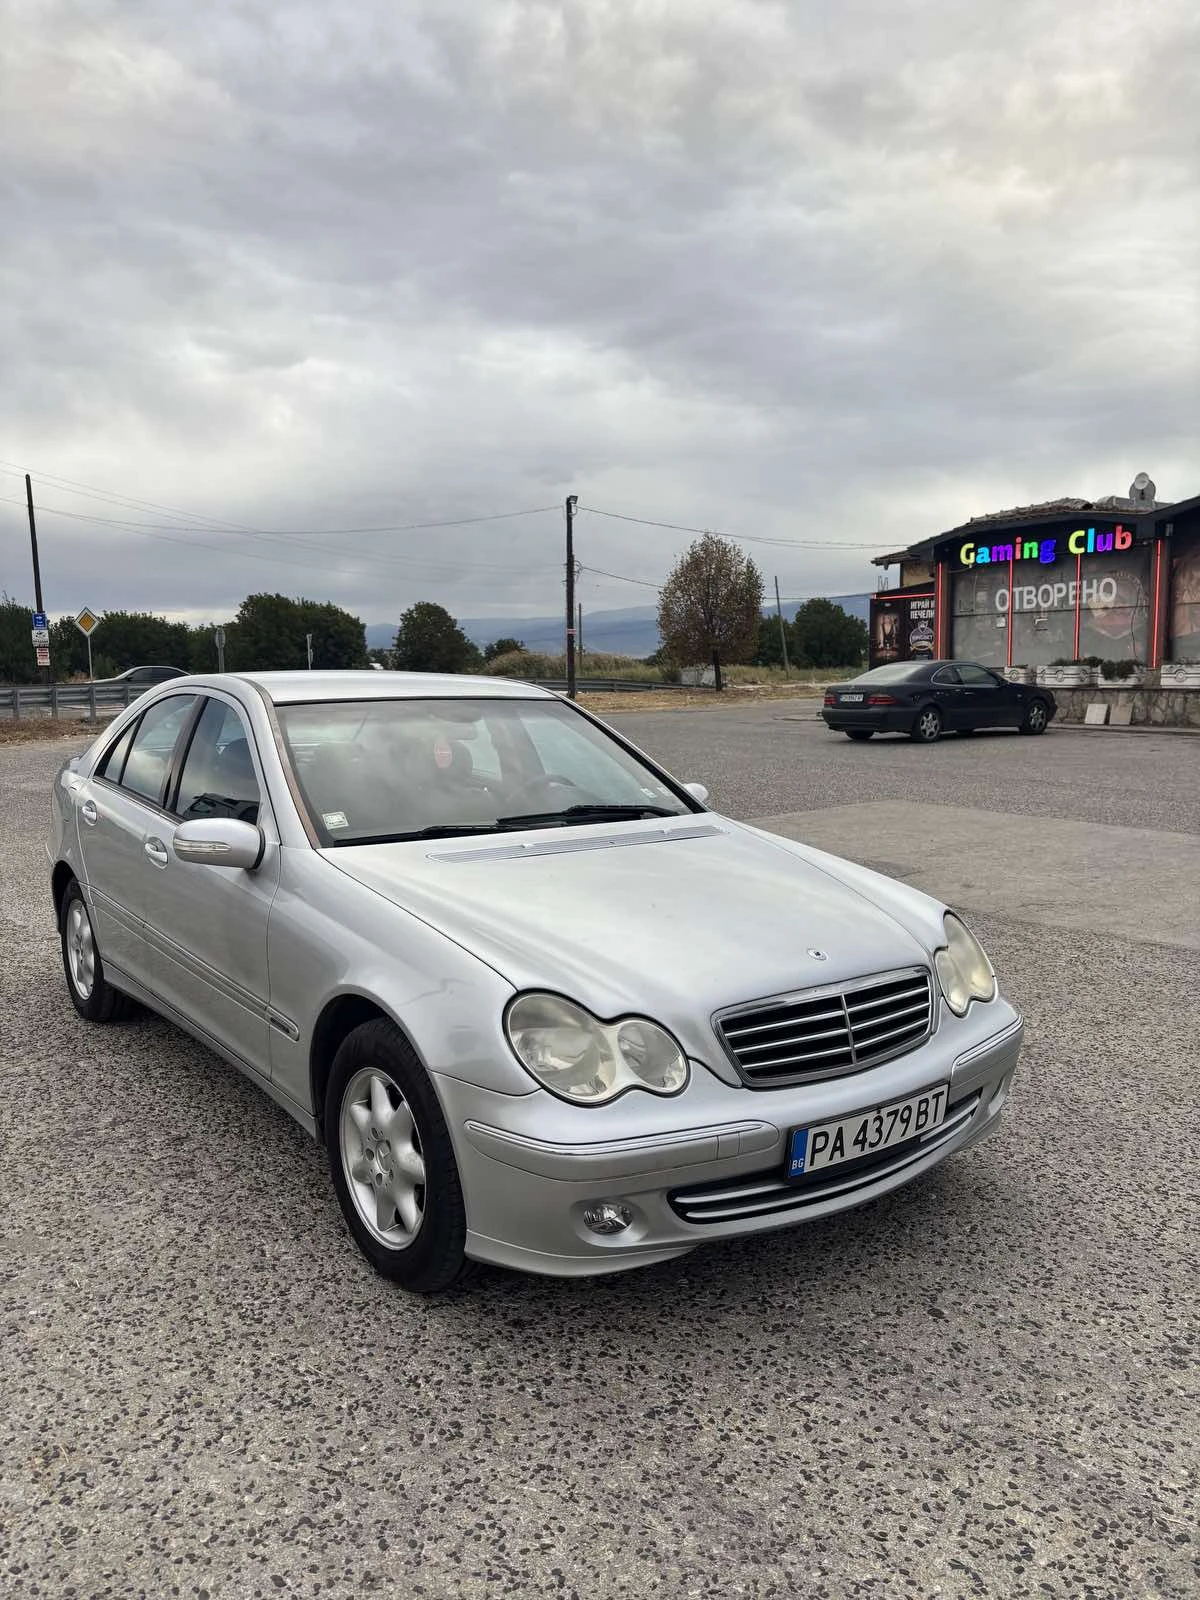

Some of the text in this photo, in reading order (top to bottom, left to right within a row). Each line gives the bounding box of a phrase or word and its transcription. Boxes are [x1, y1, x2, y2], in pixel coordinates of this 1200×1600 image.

[960, 525, 1132, 566] Gaming Club
[995, 577, 1117, 611] ОТВОРЕНО
[791, 1158, 804, 1170] BG
